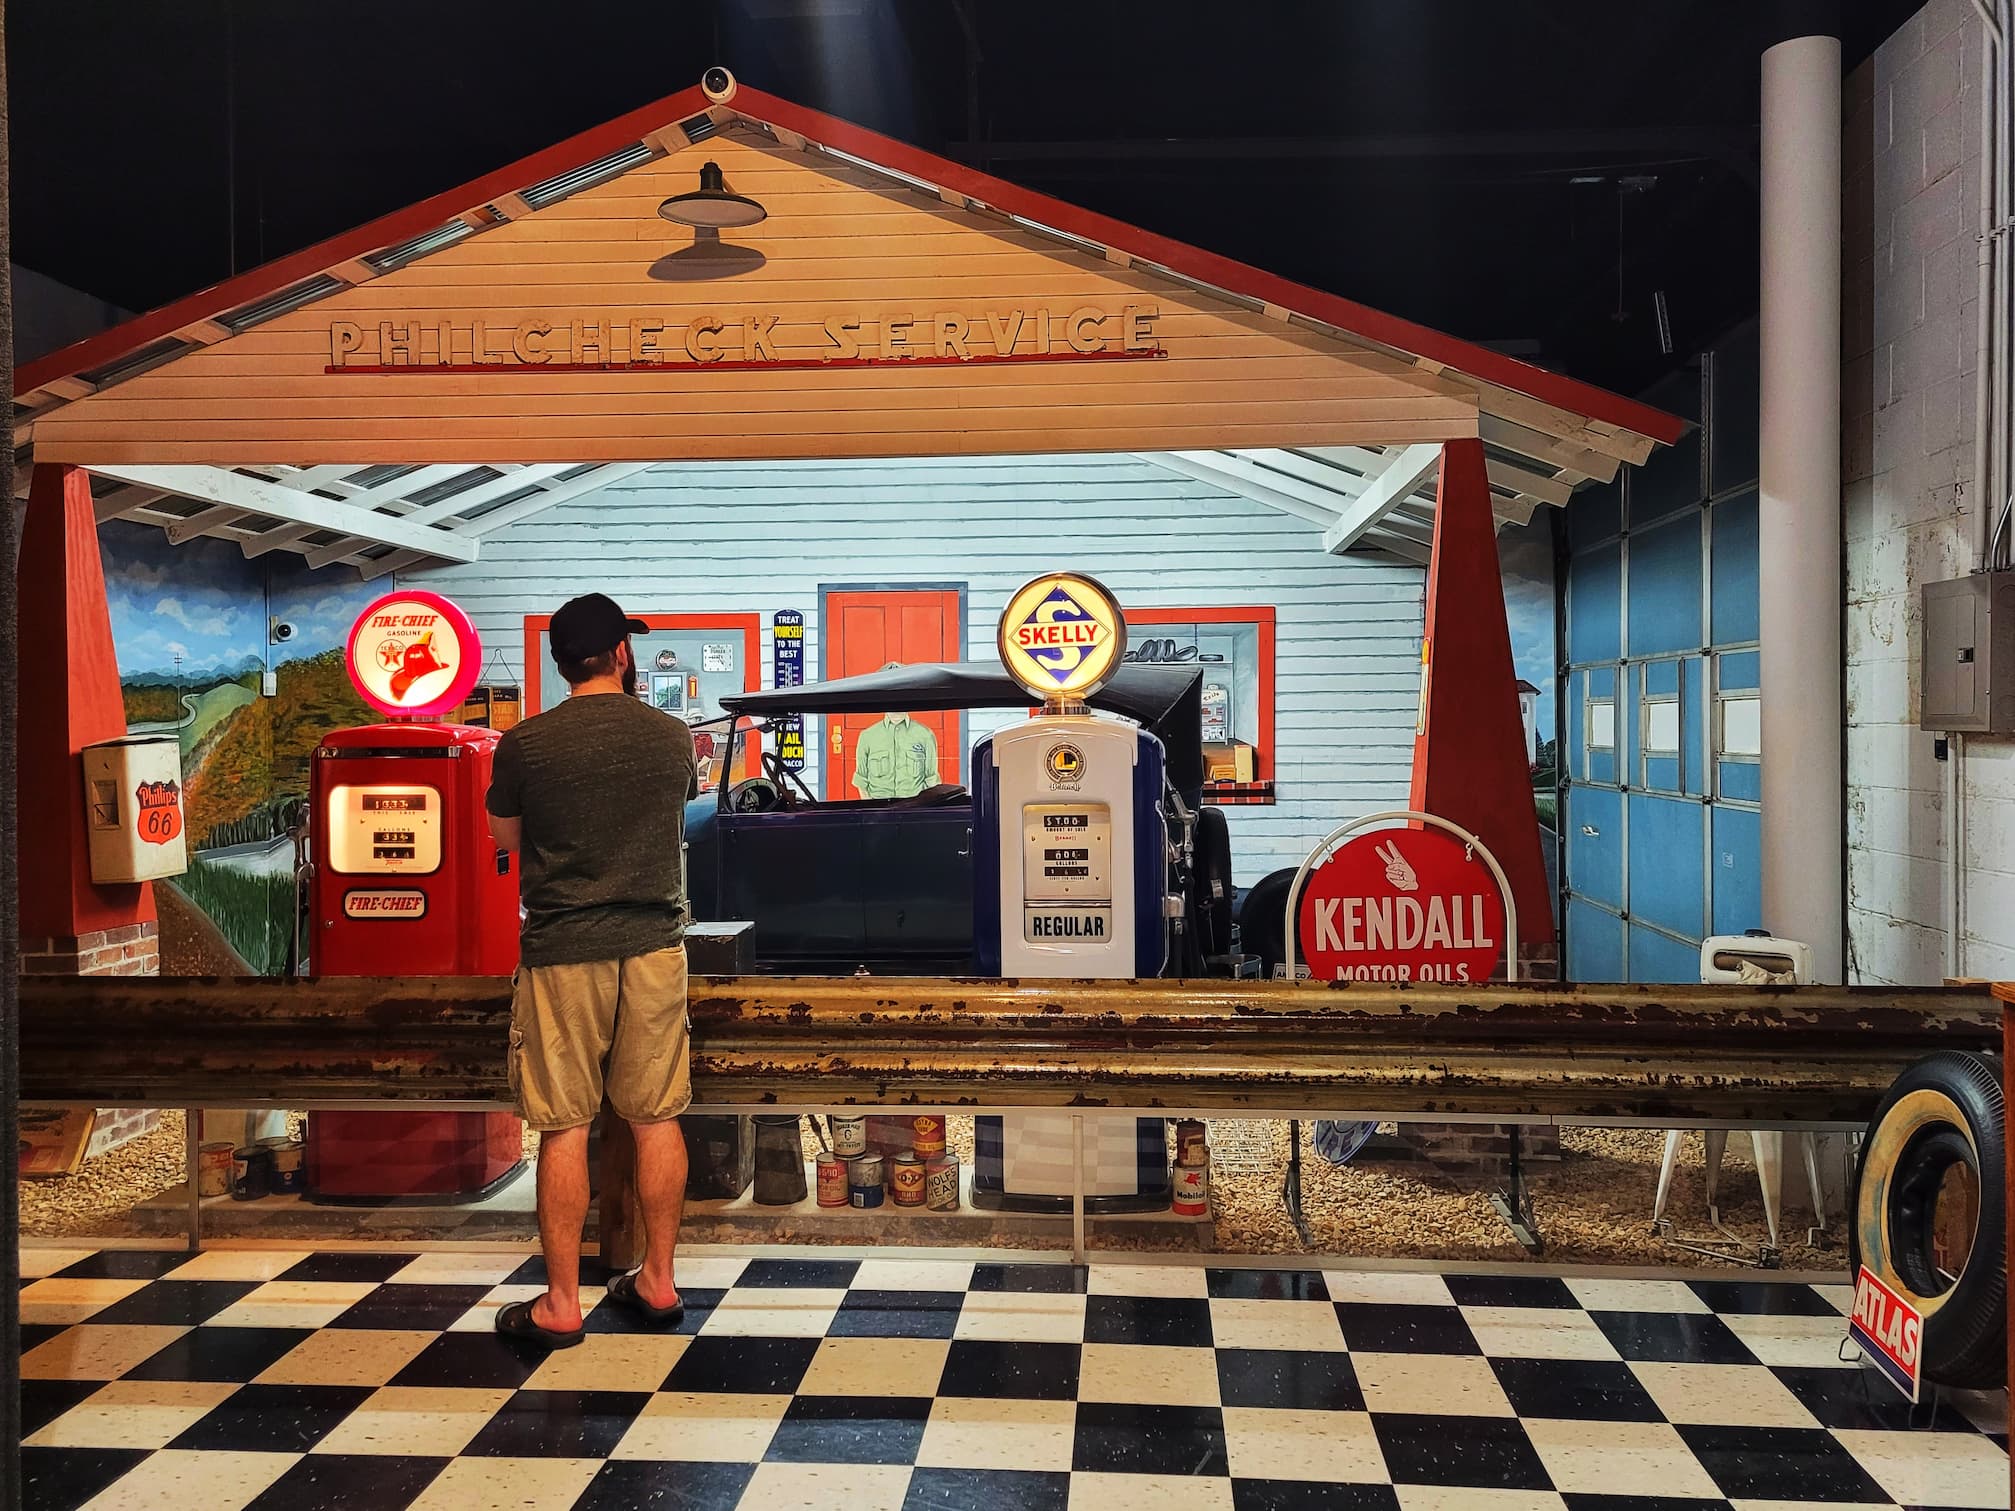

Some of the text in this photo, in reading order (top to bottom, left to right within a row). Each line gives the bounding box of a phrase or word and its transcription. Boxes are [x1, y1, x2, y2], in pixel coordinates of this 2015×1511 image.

[331, 304, 1160, 367] PHILCHECK SERVICE
[372, 615, 438, 628] FIRE-CHIEF
[778, 615, 800, 623] TREAT
[774, 625, 803, 638] YOURSELF
[1018, 624, 1098, 646] SKELLY
[777, 640, 800, 648] TO THE
[779, 650, 798, 658] BEST
[782, 746, 804, 758] OUCH
[139, 785, 177, 806] Phillips
[148, 810, 173, 835] 66
[349, 896, 423, 911] FIRE-CHIEF
[1033, 916, 1104, 937] REGULAR
[1314, 894, 1494, 952] KENDALL
[1336, 963, 1470, 982] MOTOR OILS
[928, 1180, 957, 1200] HEAD
[1853, 1275, 1919, 1368] ATLAS
